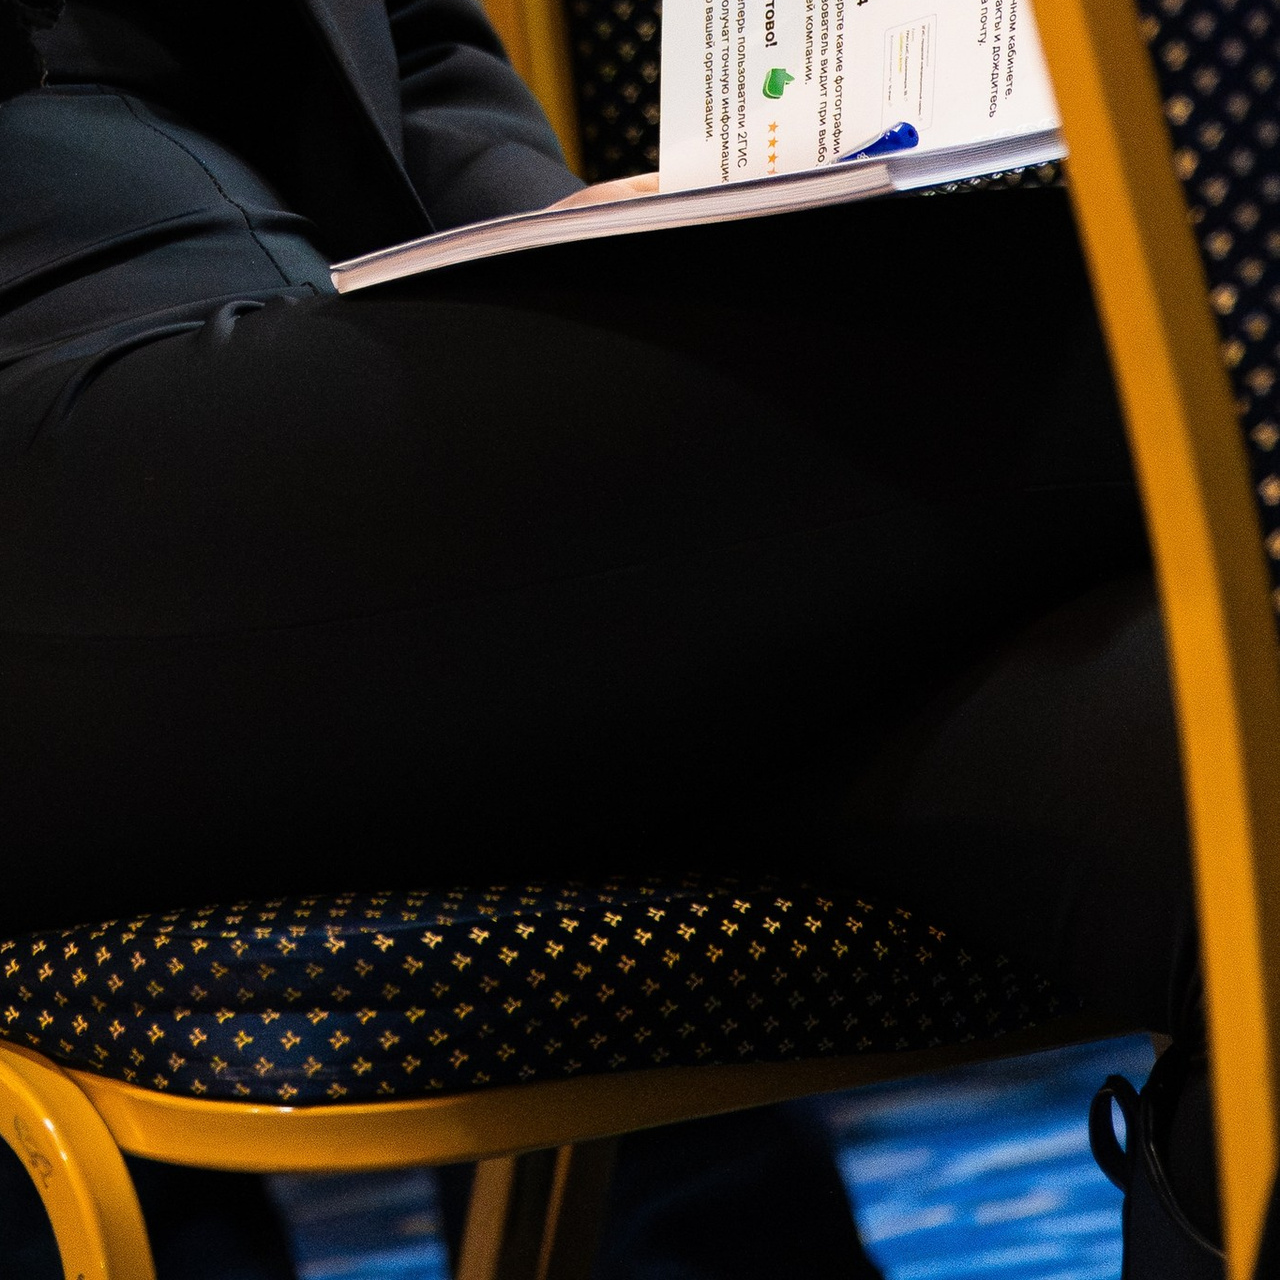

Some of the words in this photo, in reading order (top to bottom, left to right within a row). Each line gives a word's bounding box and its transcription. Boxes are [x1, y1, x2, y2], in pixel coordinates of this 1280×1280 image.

[705, 7, 715, 48] вашей
[978, 7, 988, 47] почту.
[994, 35, 1002, 43] и
[720, 46, 730, 94] точную
[804, 16, 813, 85] компании.
[835, 34, 845, 72] какие
[1005, 36, 1017, 100] кабинете.
[704, 52, 714, 142] организации.
[737, 37, 746, 128] пользователи
[819, 59, 828, 97] видит
[989, 46, 1001, 118] дождитесь
[818, 101, 827, 126] при
[832, 75, 844, 154] фотографии
[737, 131, 747, 168] 2ГИС
[816, 129, 827, 167] выбо
